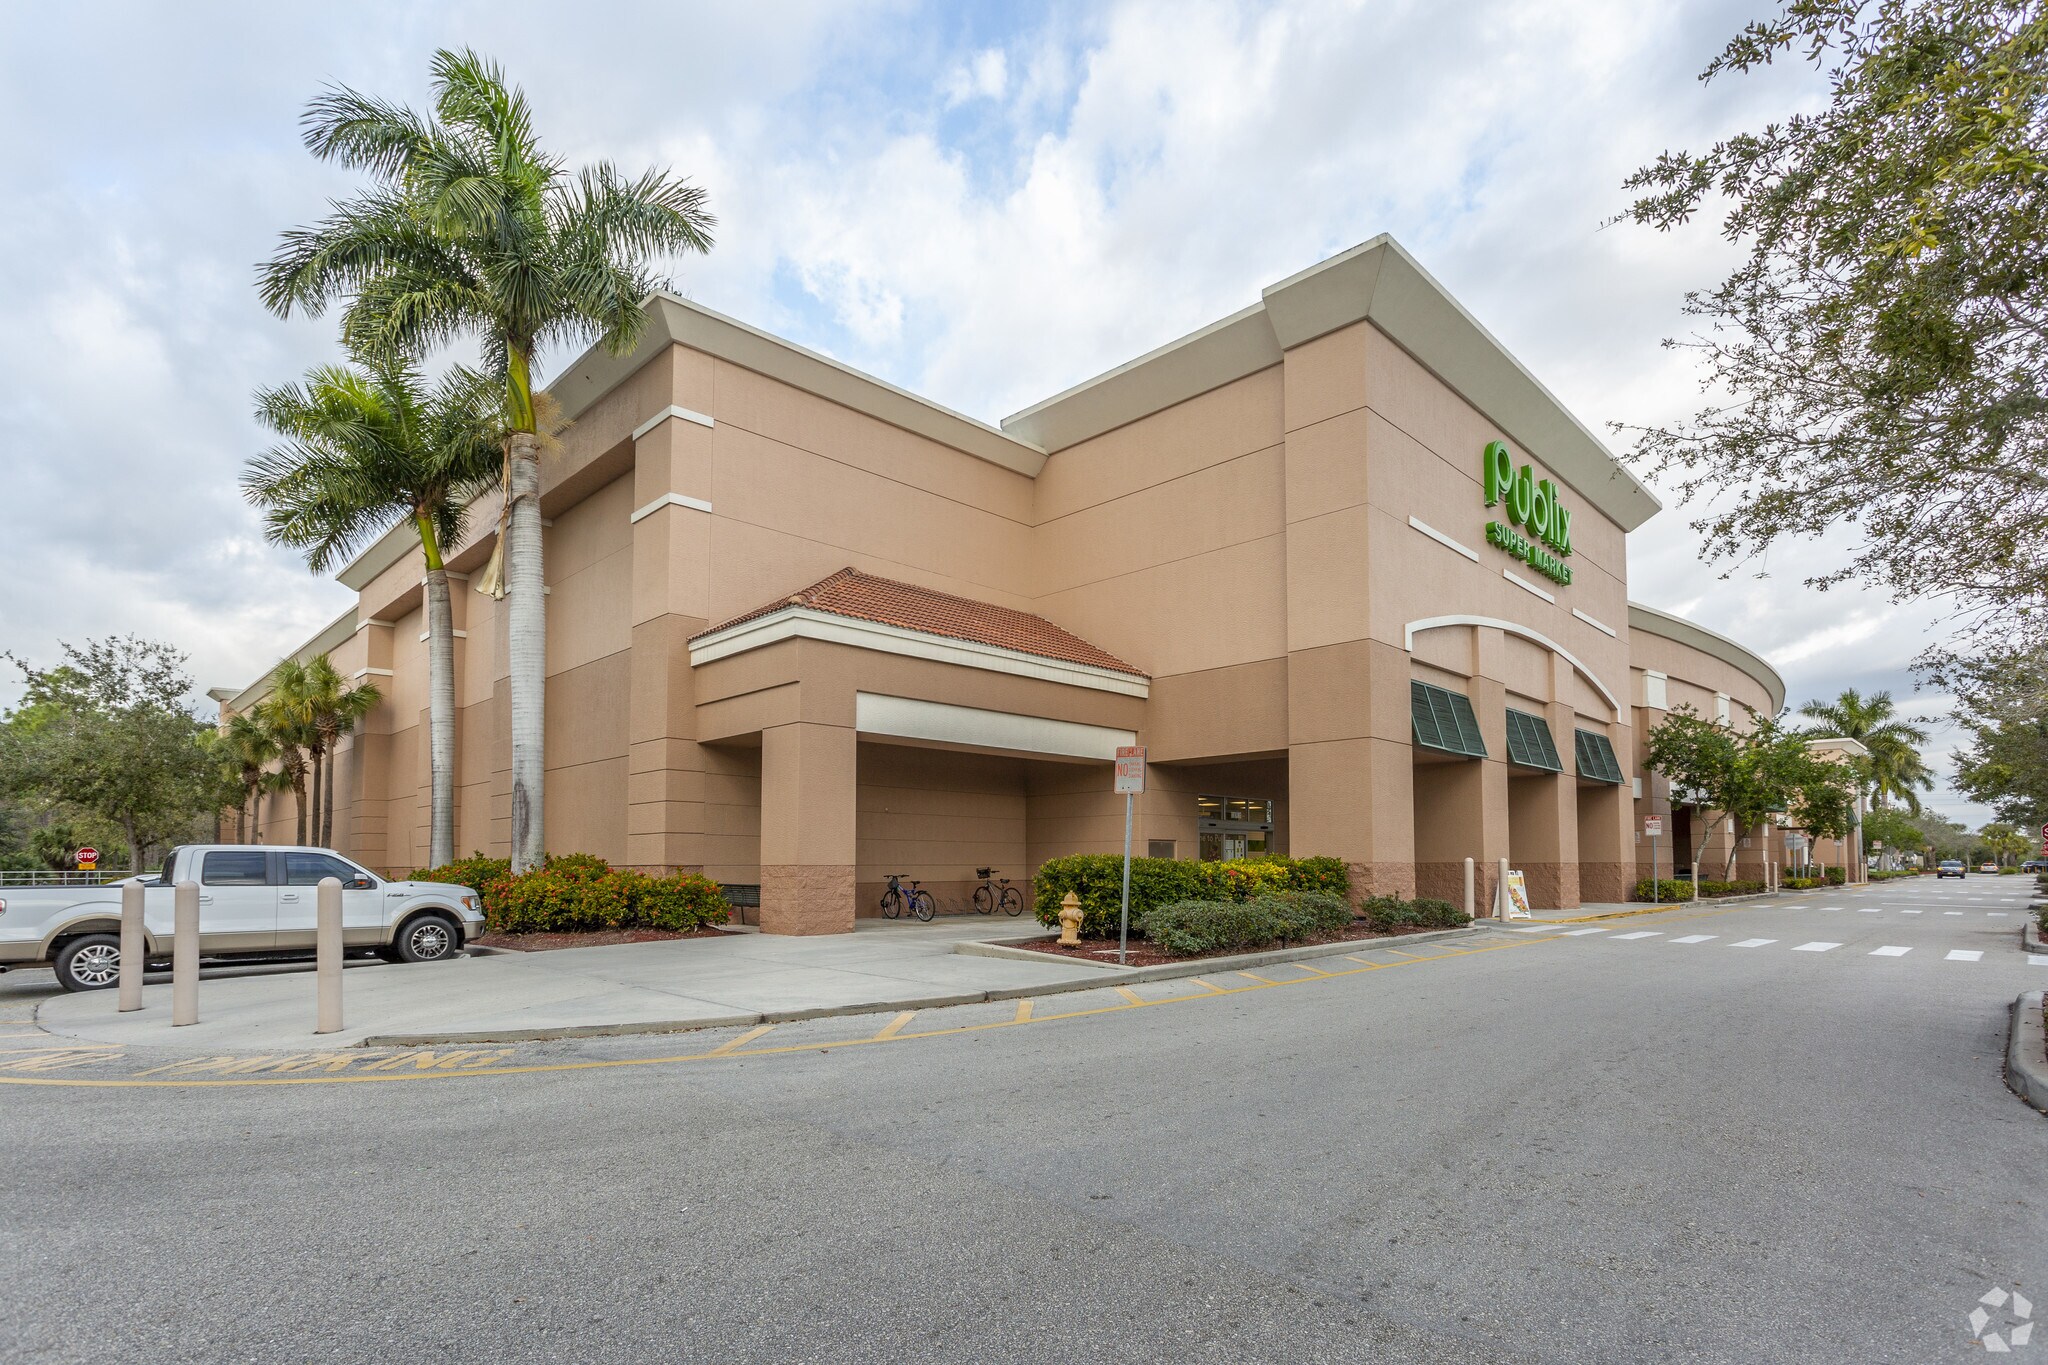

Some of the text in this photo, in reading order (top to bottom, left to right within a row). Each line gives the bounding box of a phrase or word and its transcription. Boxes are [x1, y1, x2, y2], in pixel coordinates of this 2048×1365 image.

[1483, 439, 1573, 557] Publix
[1485, 520, 1574, 587] SUPER MARKET
[1117, 763, 1129, 777] NO
[133, 1048, 518, 1077] PARKING
